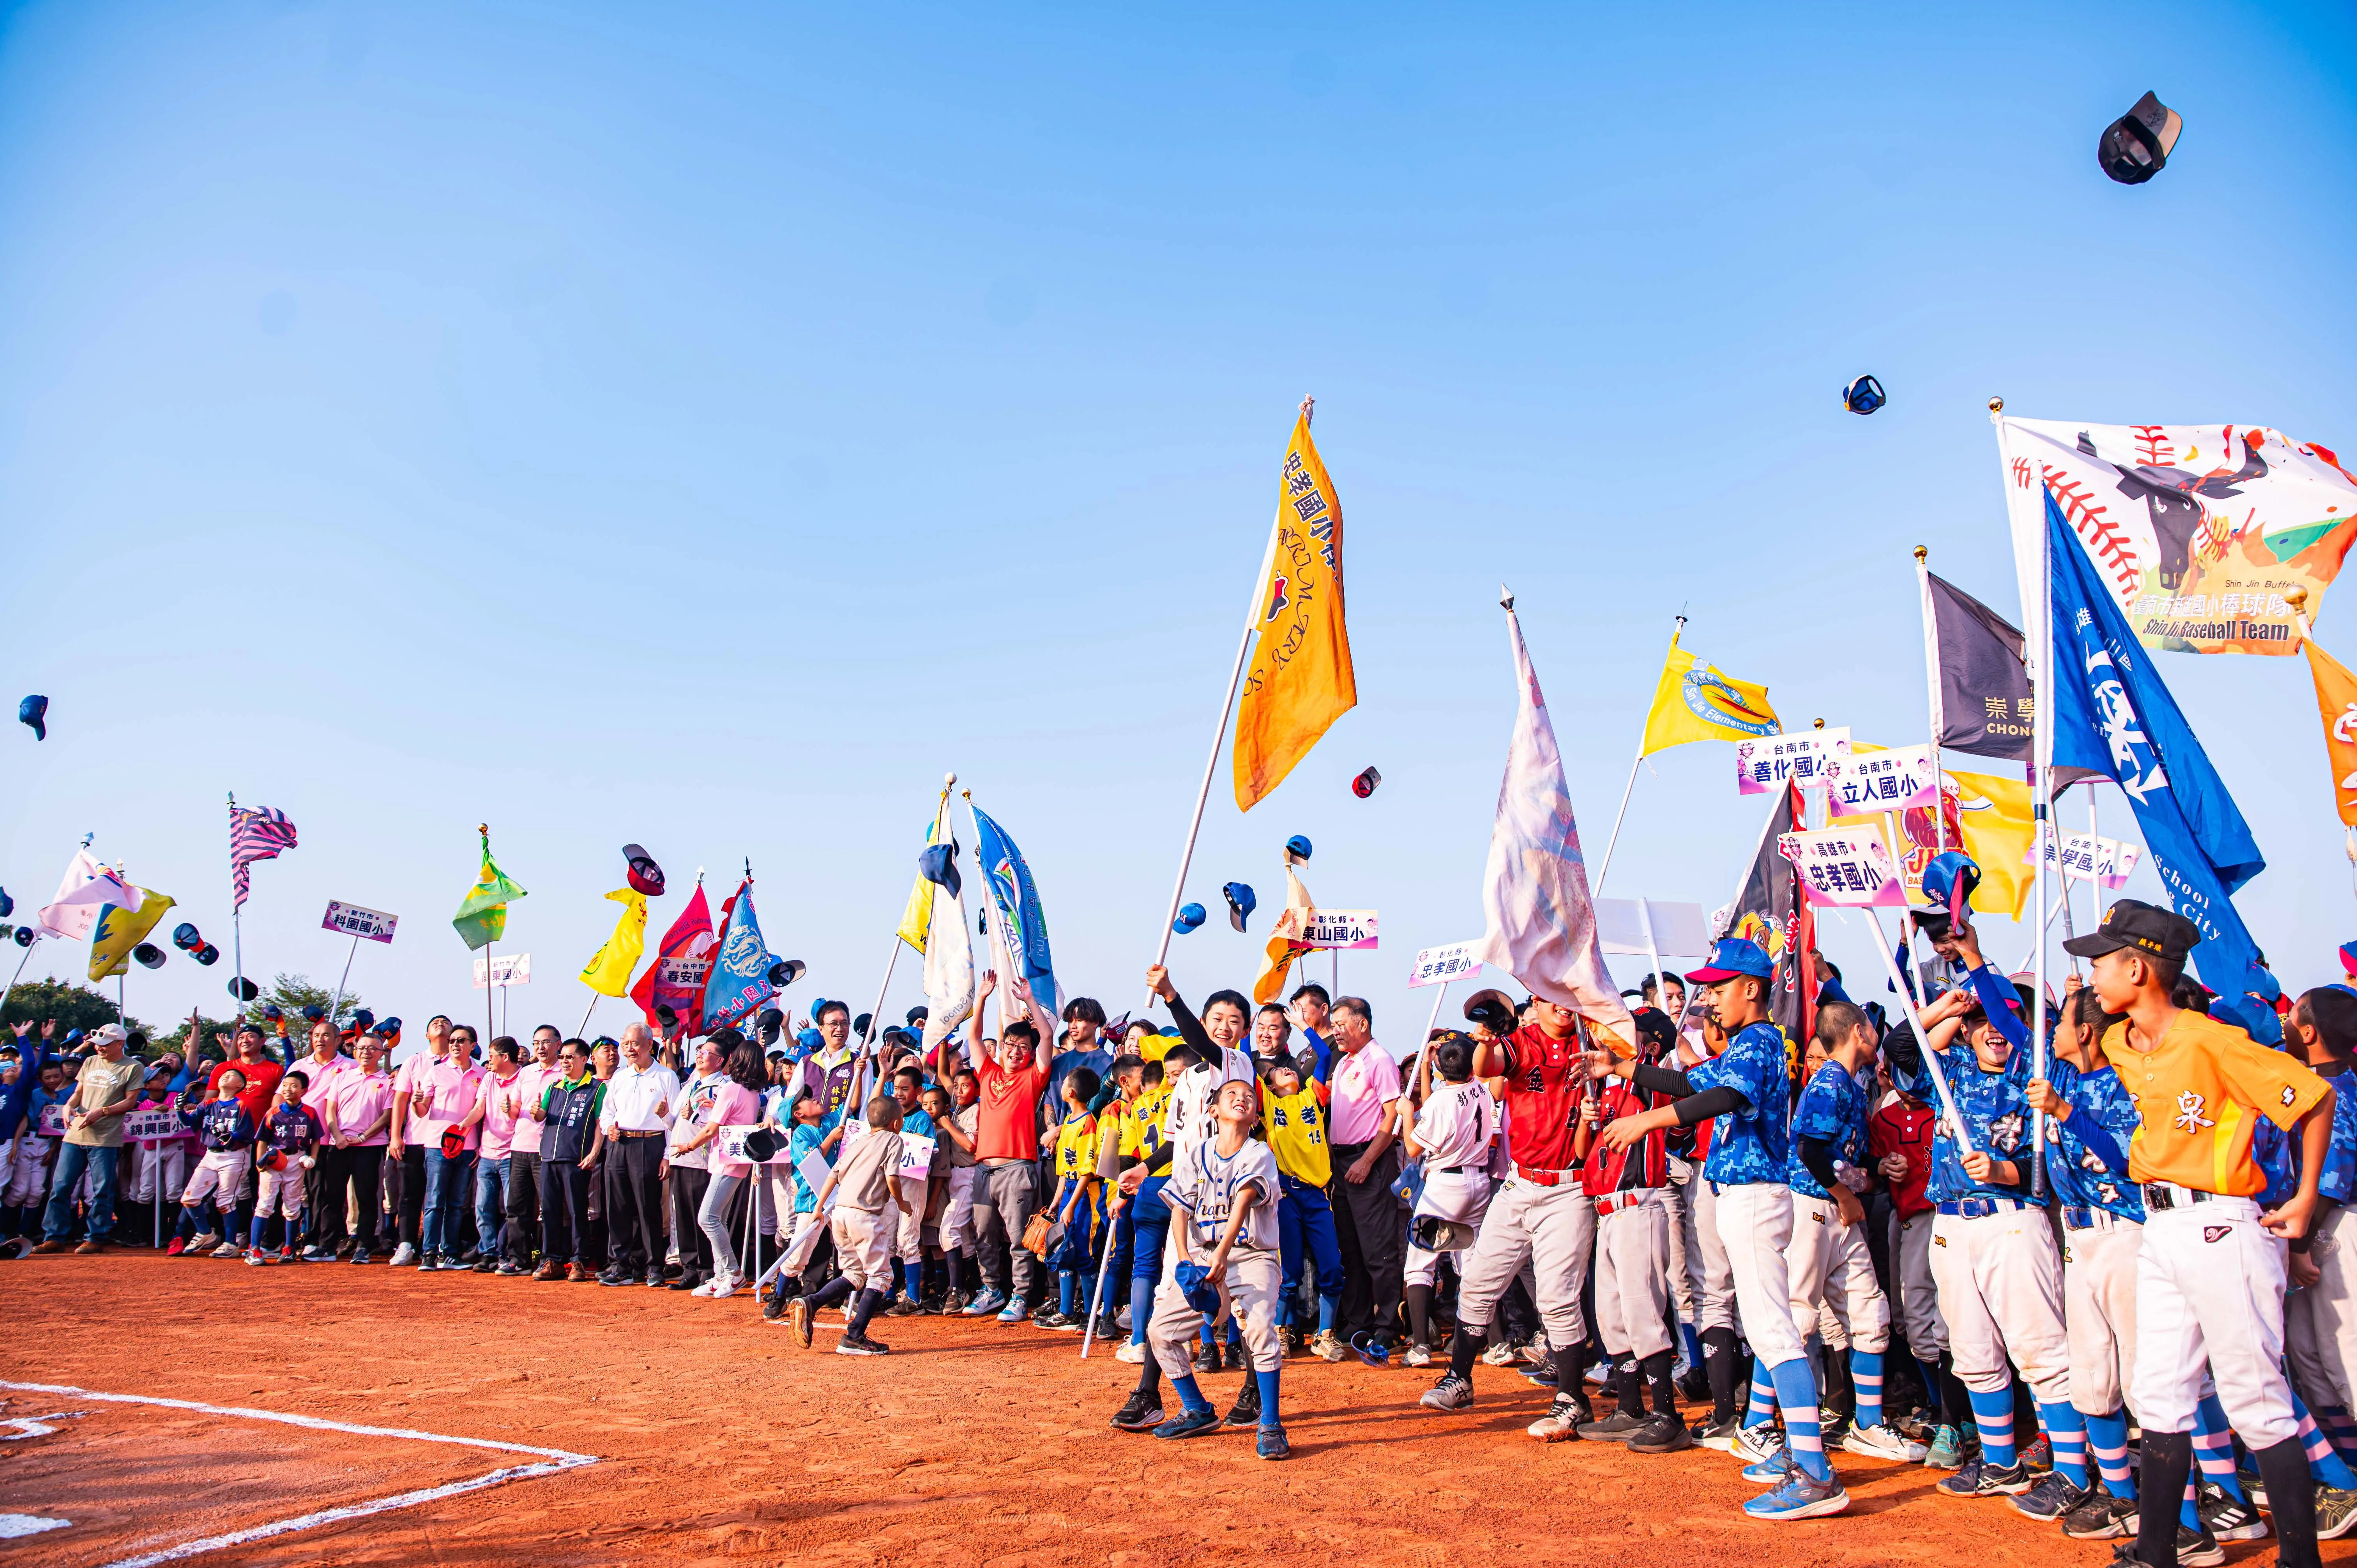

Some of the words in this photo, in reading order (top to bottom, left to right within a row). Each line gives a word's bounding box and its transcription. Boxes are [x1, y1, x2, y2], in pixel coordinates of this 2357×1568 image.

[2143, 619, 2168, 636] Shin
[2181, 621, 2236, 639] Baseball
[2240, 621, 2289, 640] Team
[1685, 687, 1697, 701] Sin
[1692, 701, 1705, 713] Jie
[1705, 709, 1764, 735] Elementary
[1774, 741, 1809, 755] 台南市
[1859, 759, 1892, 775] 台南市
[1842, 773, 1919, 804] 立人國小
[1816, 841, 1848, 857] 高雄市
[1809, 860, 1882, 892] 忠孝國小
[2154, 855, 2210, 909] School
[351, 909, 374, 920] 新竹市
[1180, 912, 1187, 923] M
[2182, 903, 2221, 941] City
[334, 914, 383, 935] 科園國小
[1302, 926, 1364, 941] 東山國小
[1439, 948, 1462, 958] 彰化縣
[1420, 957, 1471, 978] 忠孝國小
[667, 970, 703, 983] 春安國
[788, 1047, 800, 1056] M
[2175, 1090, 2215, 1134] 泉
[130, 1121, 184, 1136] 錦興國小
[1308, 1129, 1322, 1145] 15
